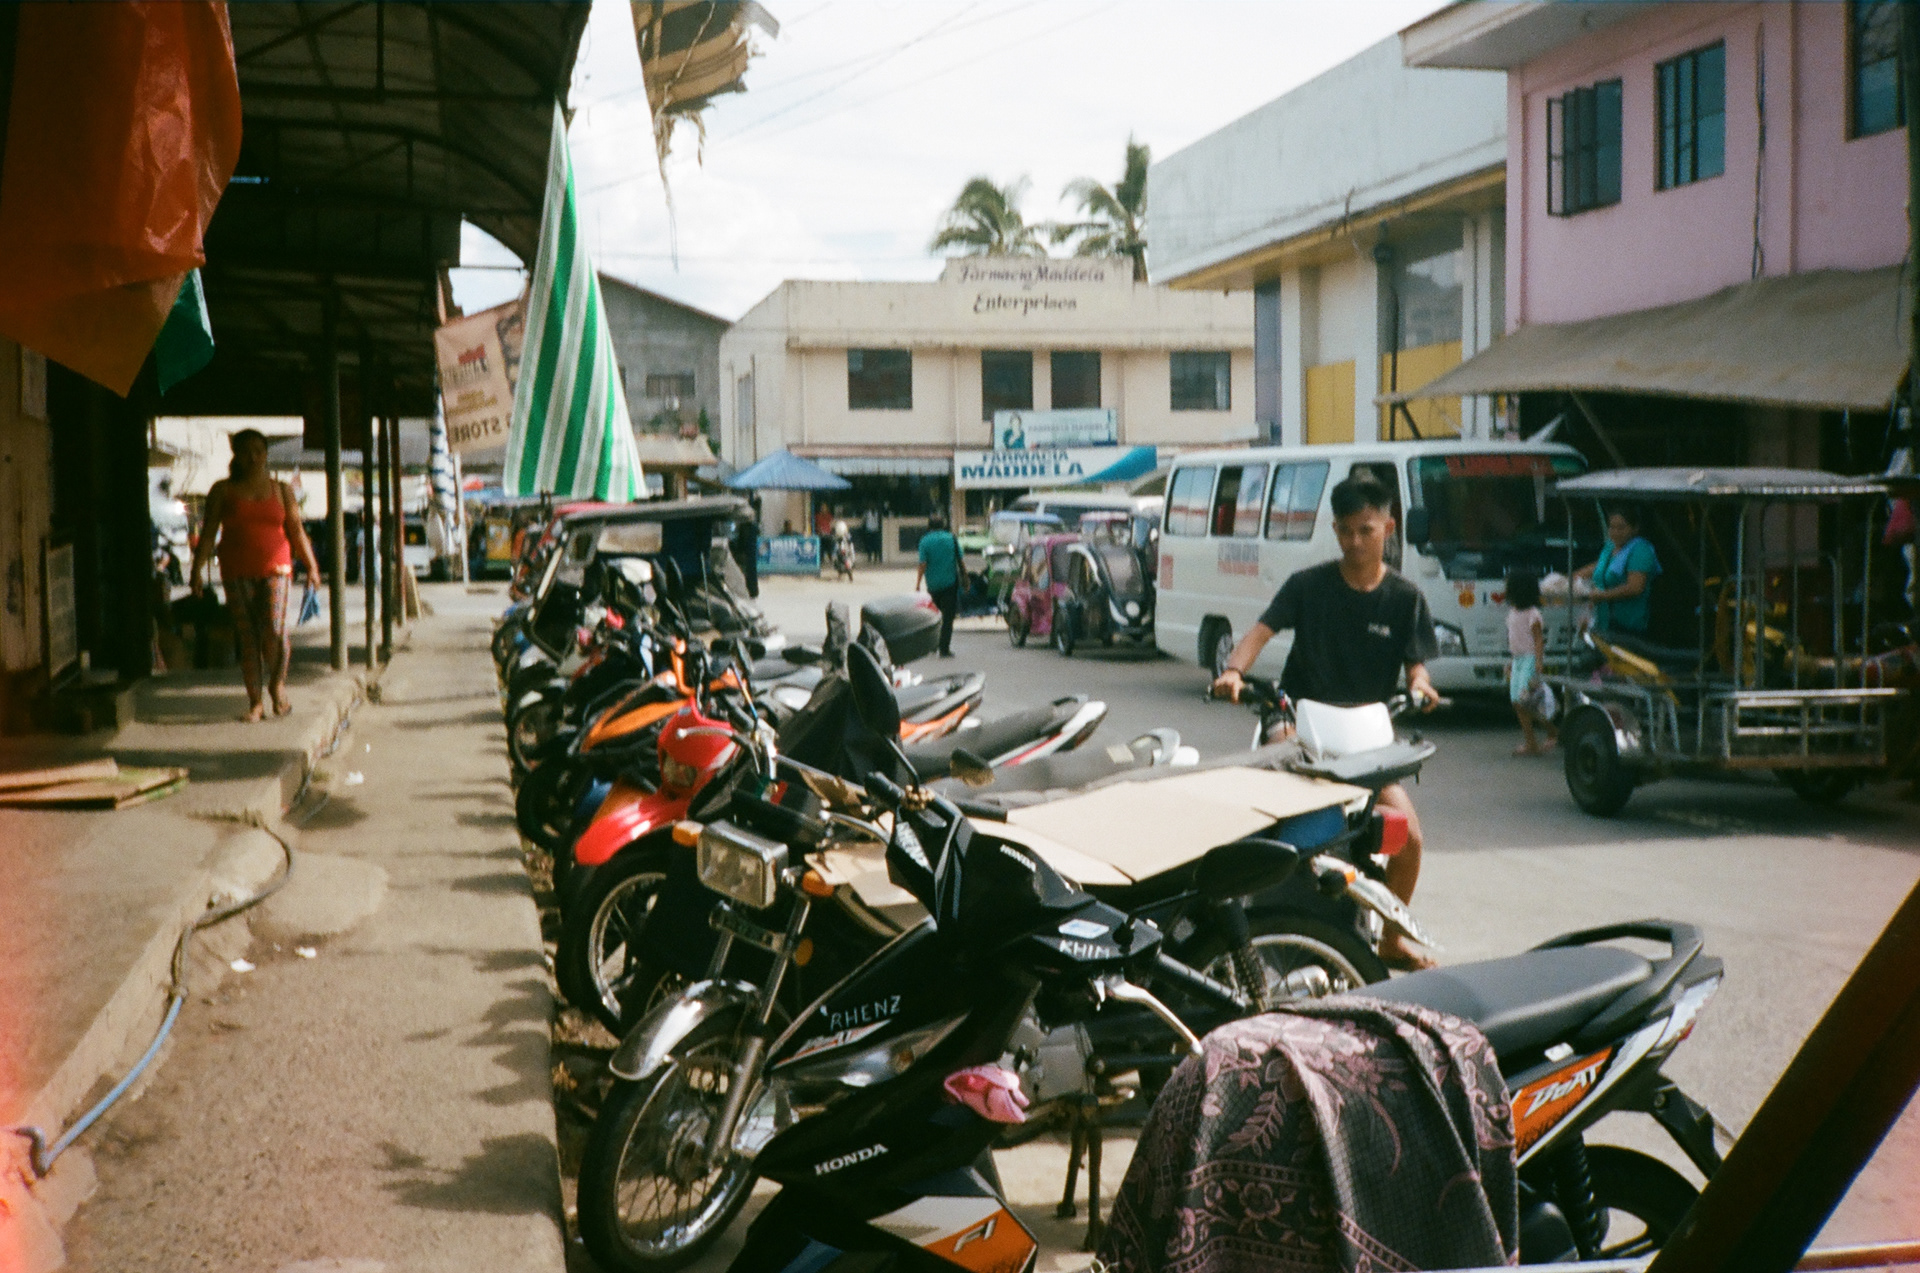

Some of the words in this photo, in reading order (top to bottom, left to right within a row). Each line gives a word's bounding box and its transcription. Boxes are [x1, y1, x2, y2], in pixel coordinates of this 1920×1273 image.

[973, 293, 1077, 316] Enterprises
[830, 995, 902, 1031] RHENZ
[814, 1143, 889, 1176] HONDA
